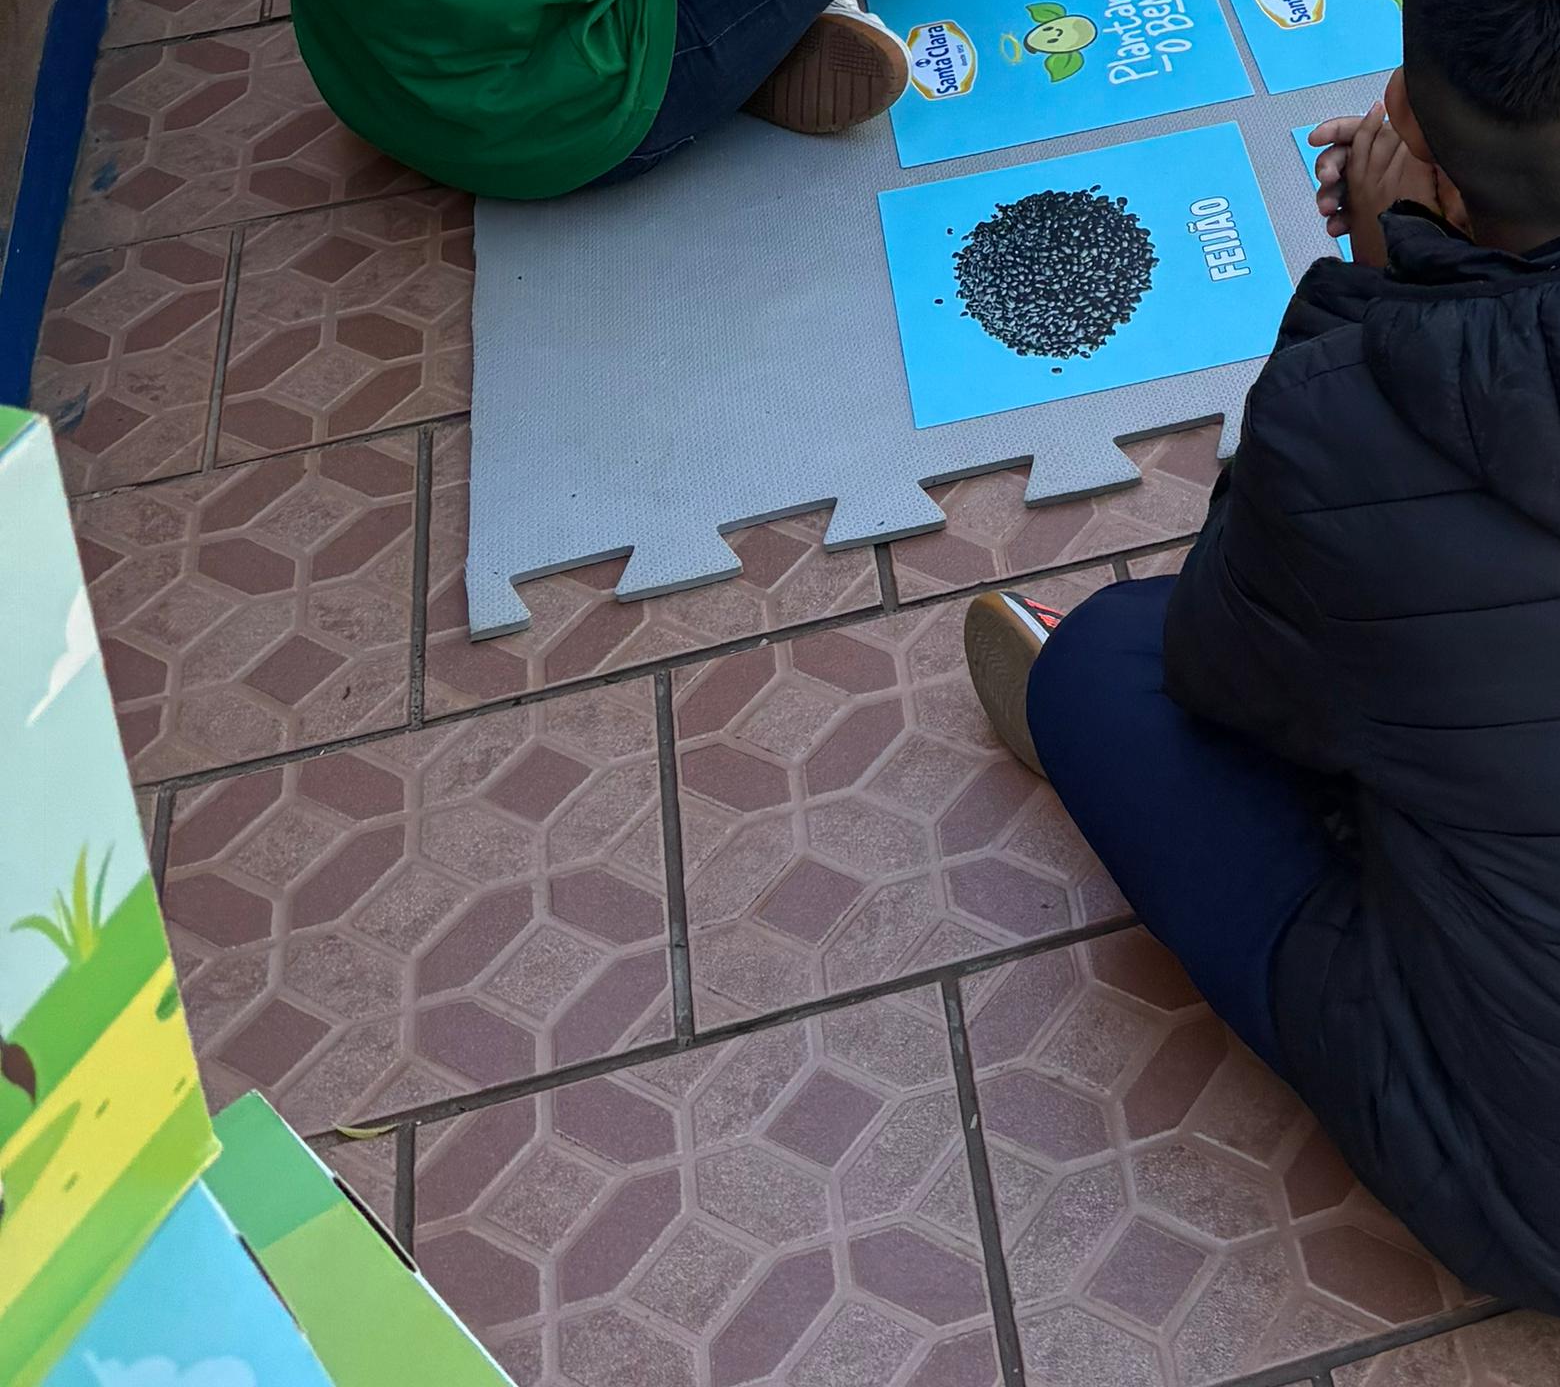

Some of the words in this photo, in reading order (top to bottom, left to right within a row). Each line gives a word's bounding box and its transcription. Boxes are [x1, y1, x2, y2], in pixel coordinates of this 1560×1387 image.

[925, 24, 949, 58] Clara
[933, 57, 959, 95] Santa
[1186, 196, 1251, 282] FEIJÃO
